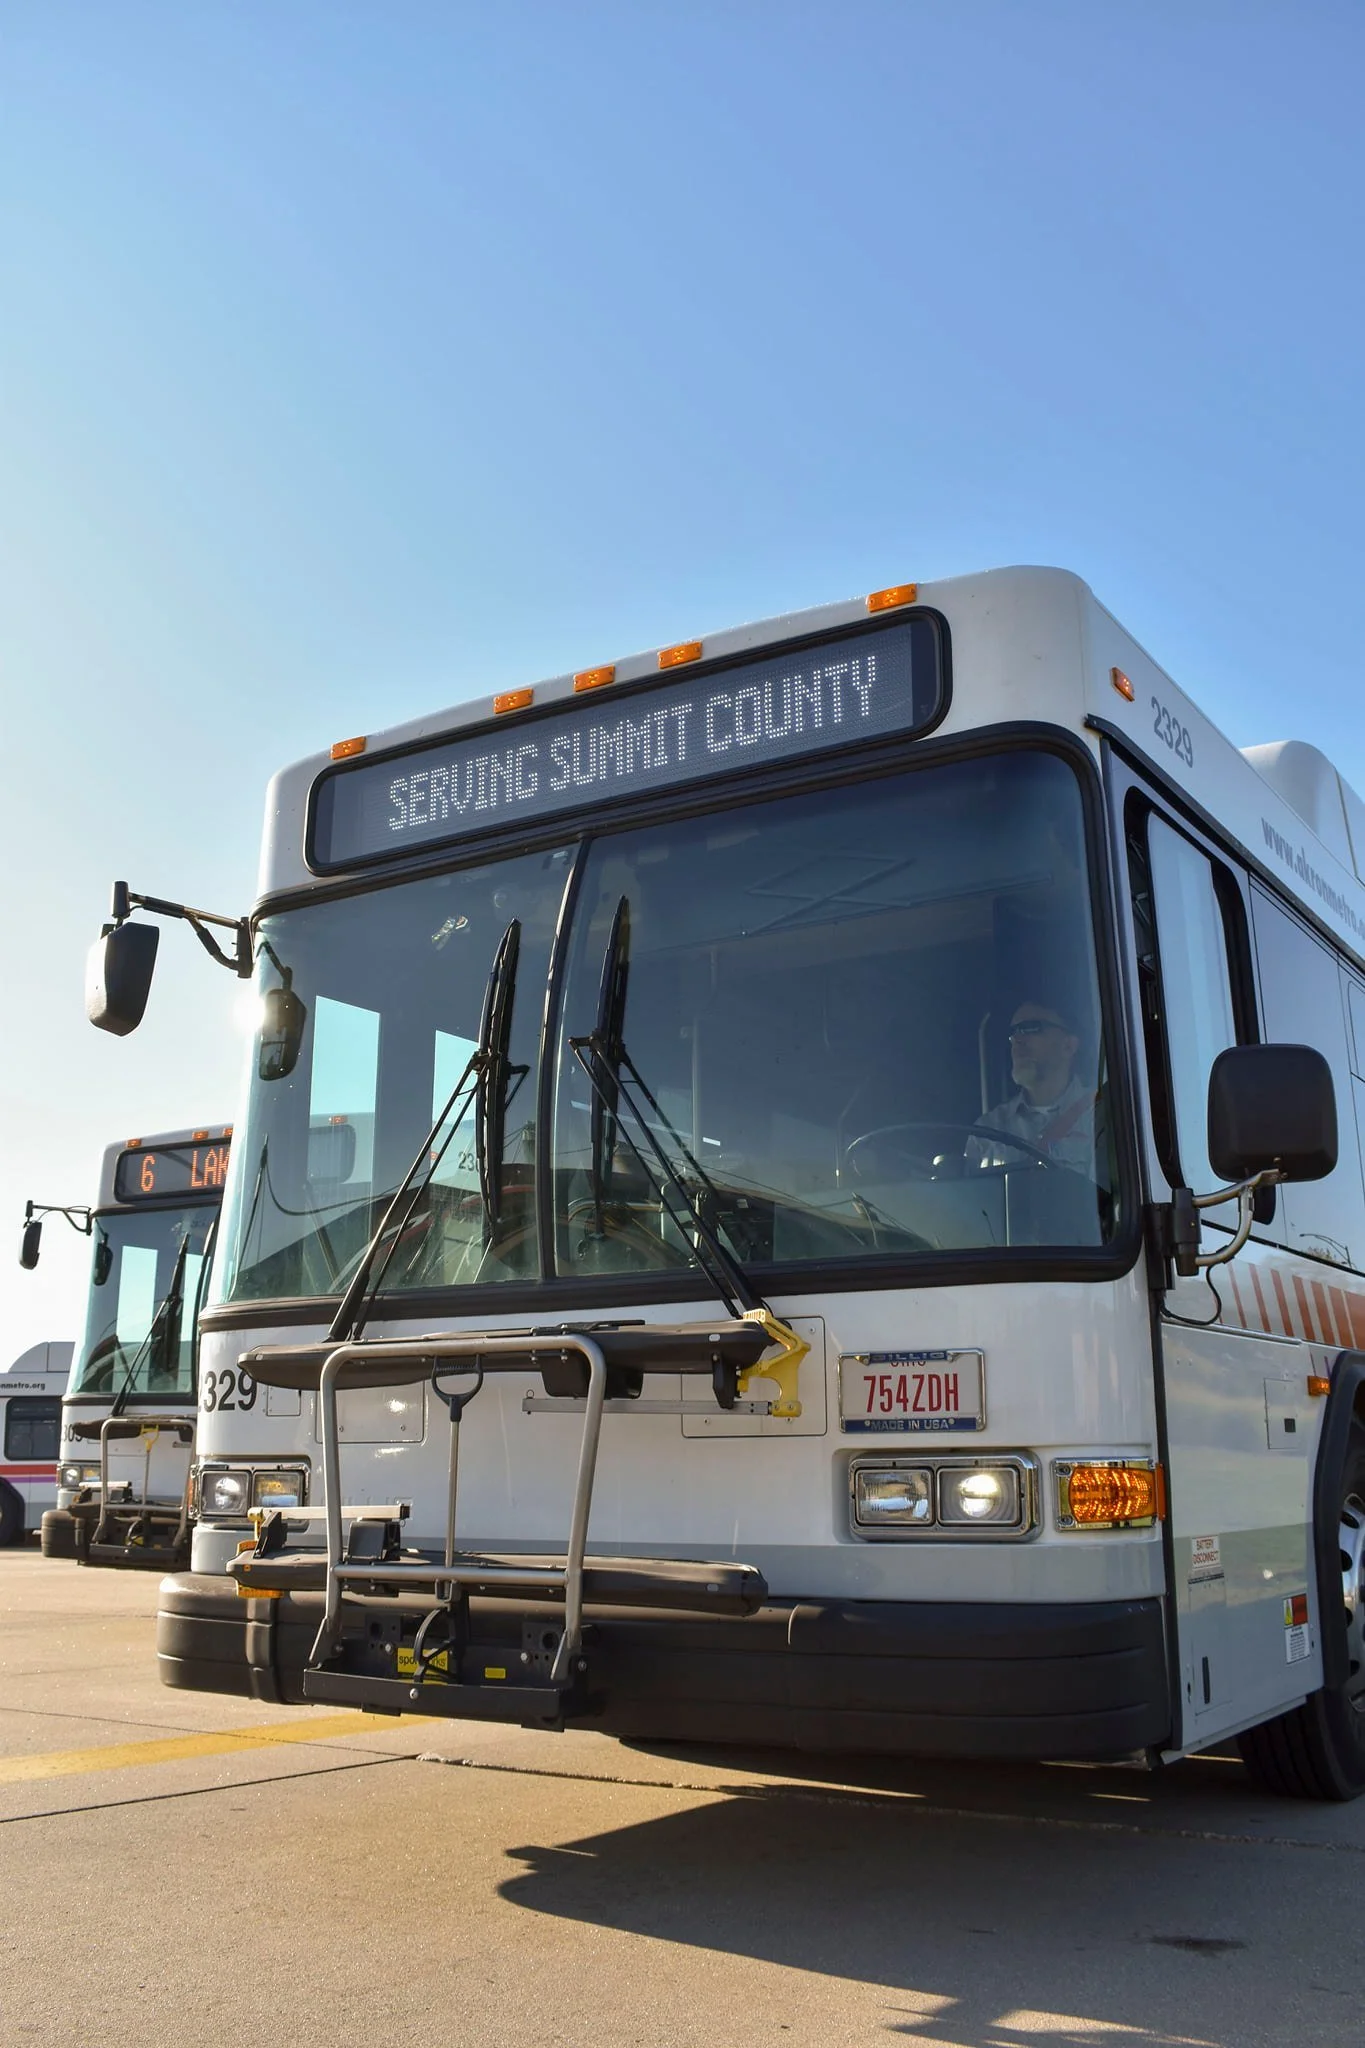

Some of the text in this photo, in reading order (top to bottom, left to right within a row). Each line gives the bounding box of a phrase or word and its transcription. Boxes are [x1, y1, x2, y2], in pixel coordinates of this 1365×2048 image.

[388, 655, 878, 832] SERVING SUMMIT COUNTY
[1151, 696, 1194, 769] 2329
[141, 1154, 155, 1192] 6
[0, 1382, 46, 1391] nmetro.org
[863, 1373, 959, 1413] 754ZDH
[870, 1418, 949, 1432] MADE IN USA
